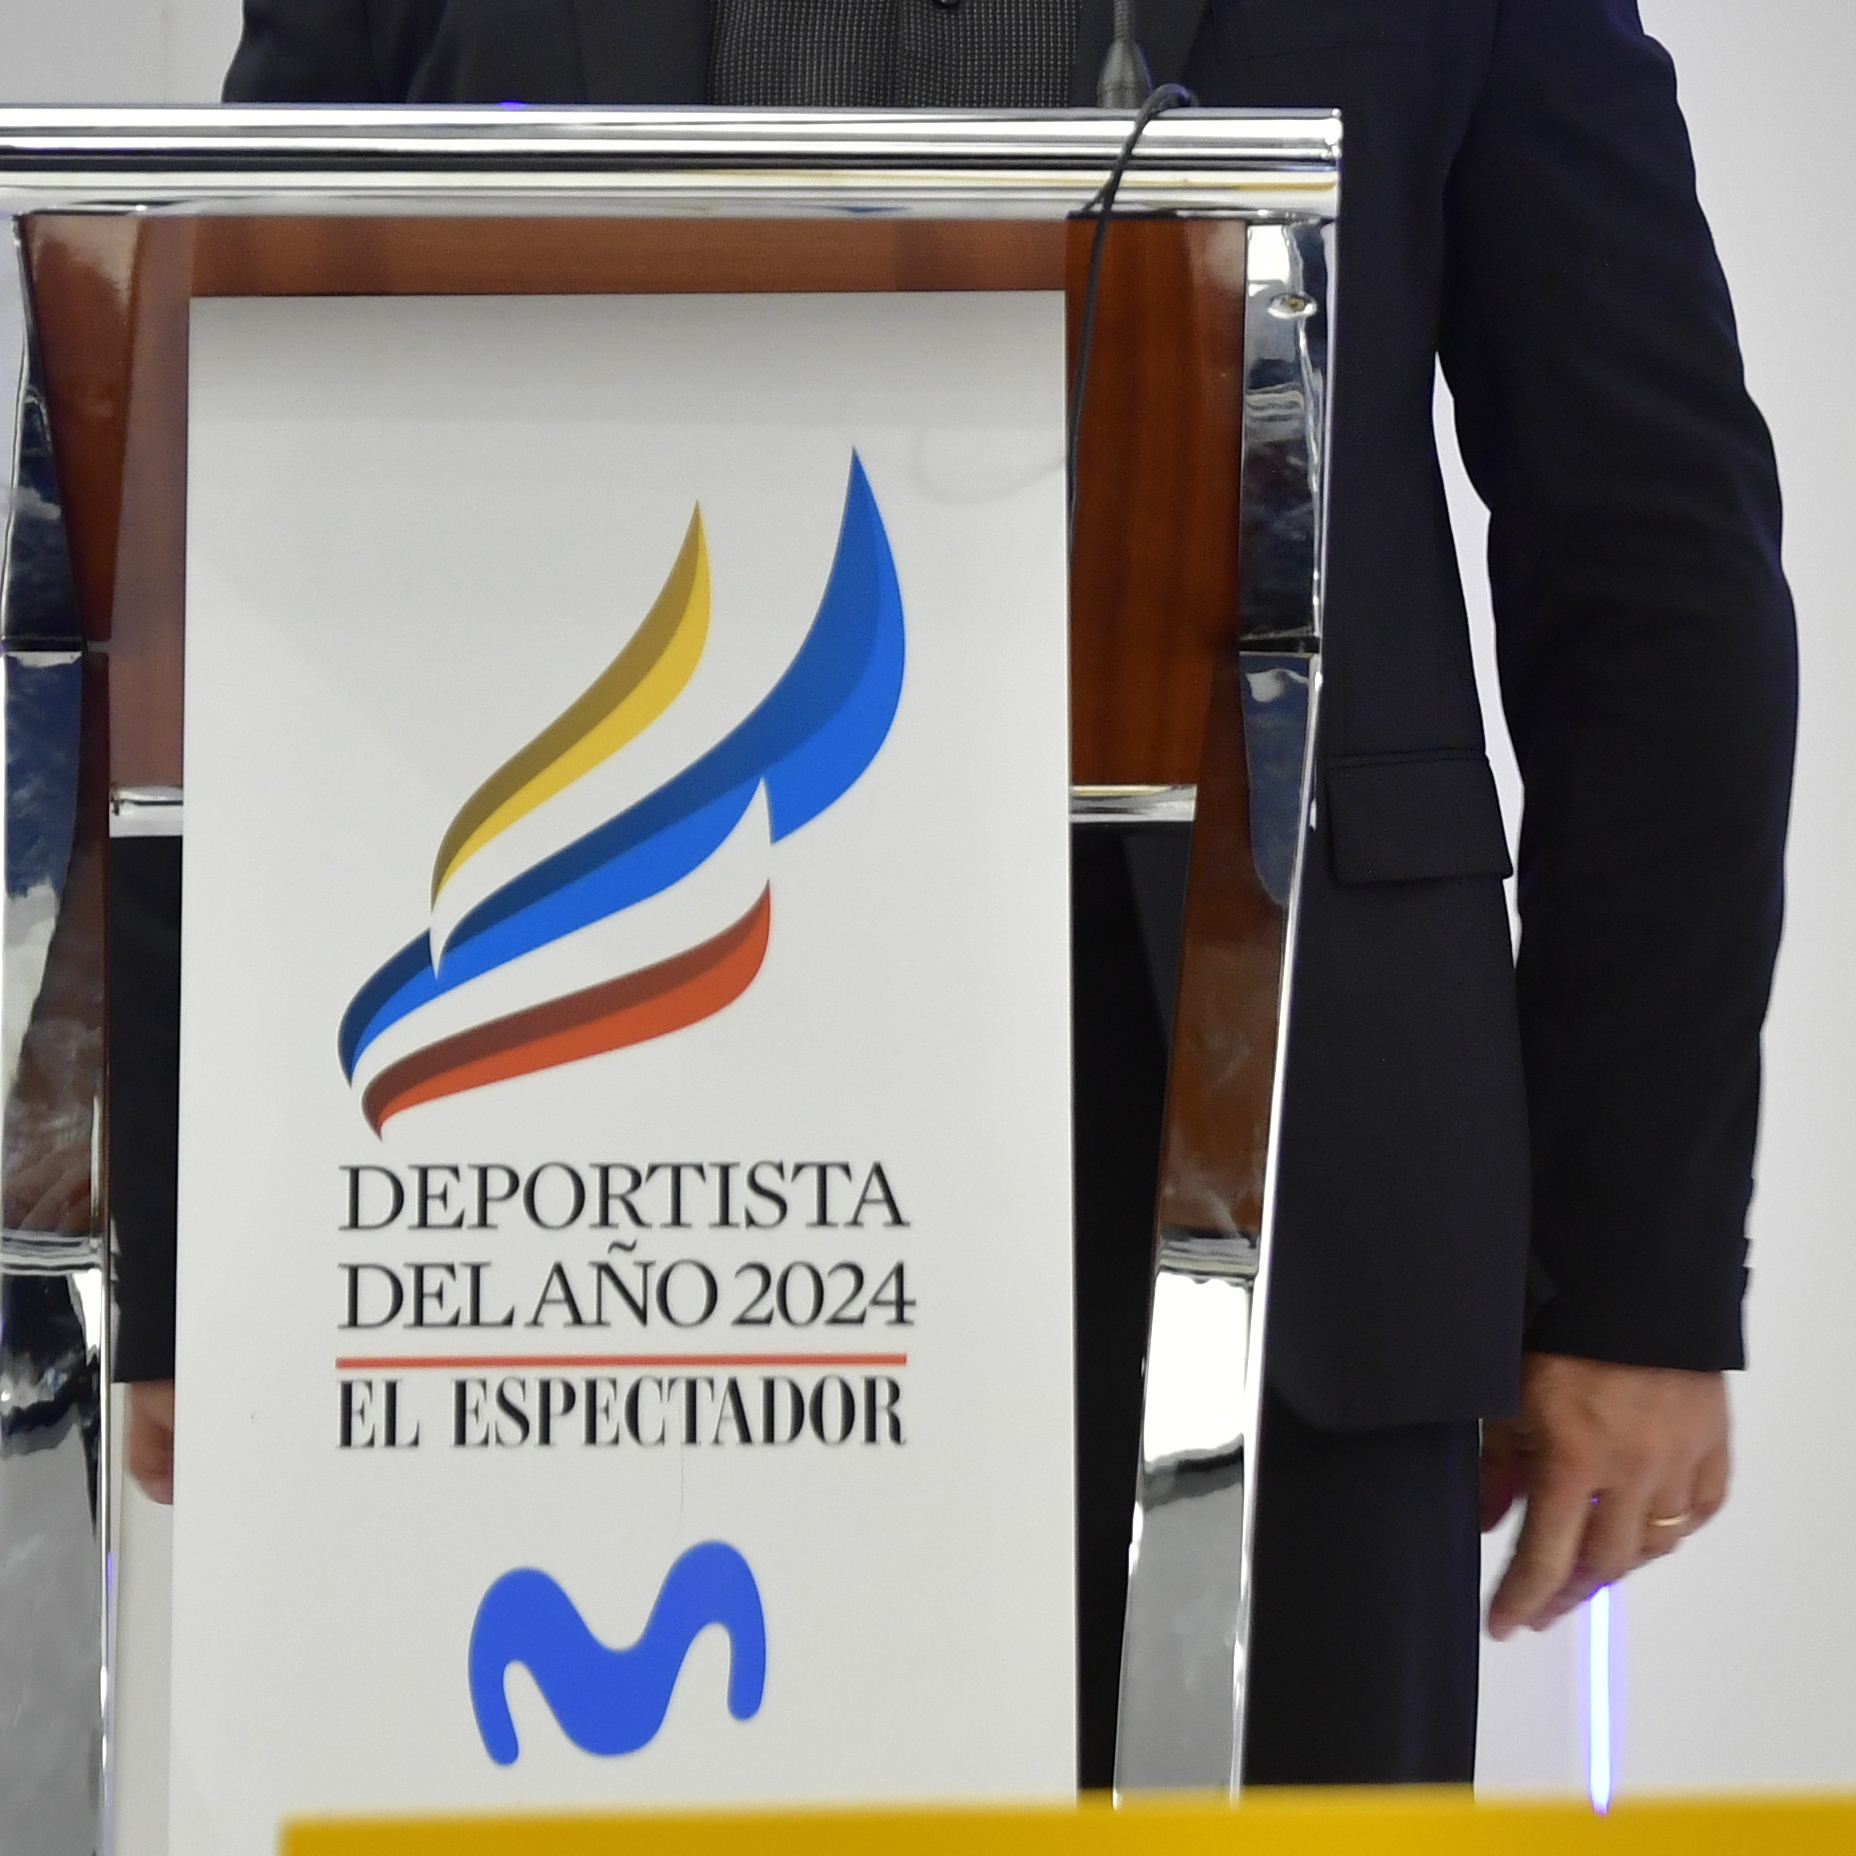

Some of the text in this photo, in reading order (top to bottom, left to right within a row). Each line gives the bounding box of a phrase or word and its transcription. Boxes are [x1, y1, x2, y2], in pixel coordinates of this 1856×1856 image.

[338, 1160, 912, 1231] DEPORTISTA
[337, 1239, 917, 1330] DEL AÑO 2024
[337, 1374, 908, 1450] EL ESPECTADOR
